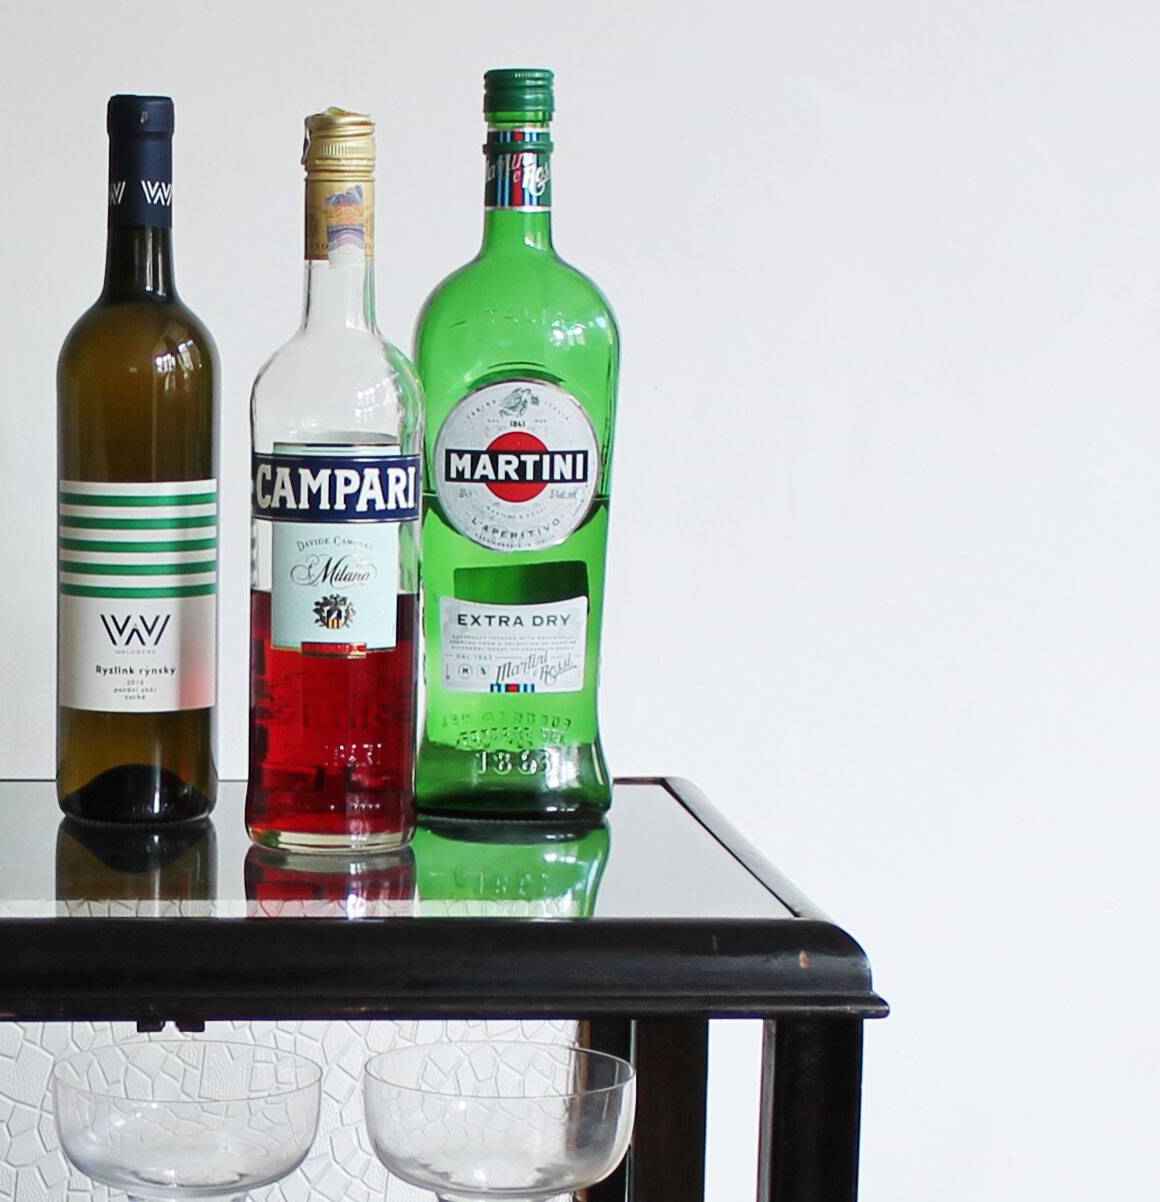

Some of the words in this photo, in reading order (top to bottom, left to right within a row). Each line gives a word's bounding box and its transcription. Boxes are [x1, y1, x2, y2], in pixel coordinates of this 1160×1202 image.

[449, 452, 584, 481] MARTINI
[256, 463, 416, 512] CAMPARI
[472, 517, 561, 539] L'APERITIVO
[290, 553, 374, 589] Milano
[457, 614, 525, 628] EXTRA
[532, 614, 571, 628] DRY
